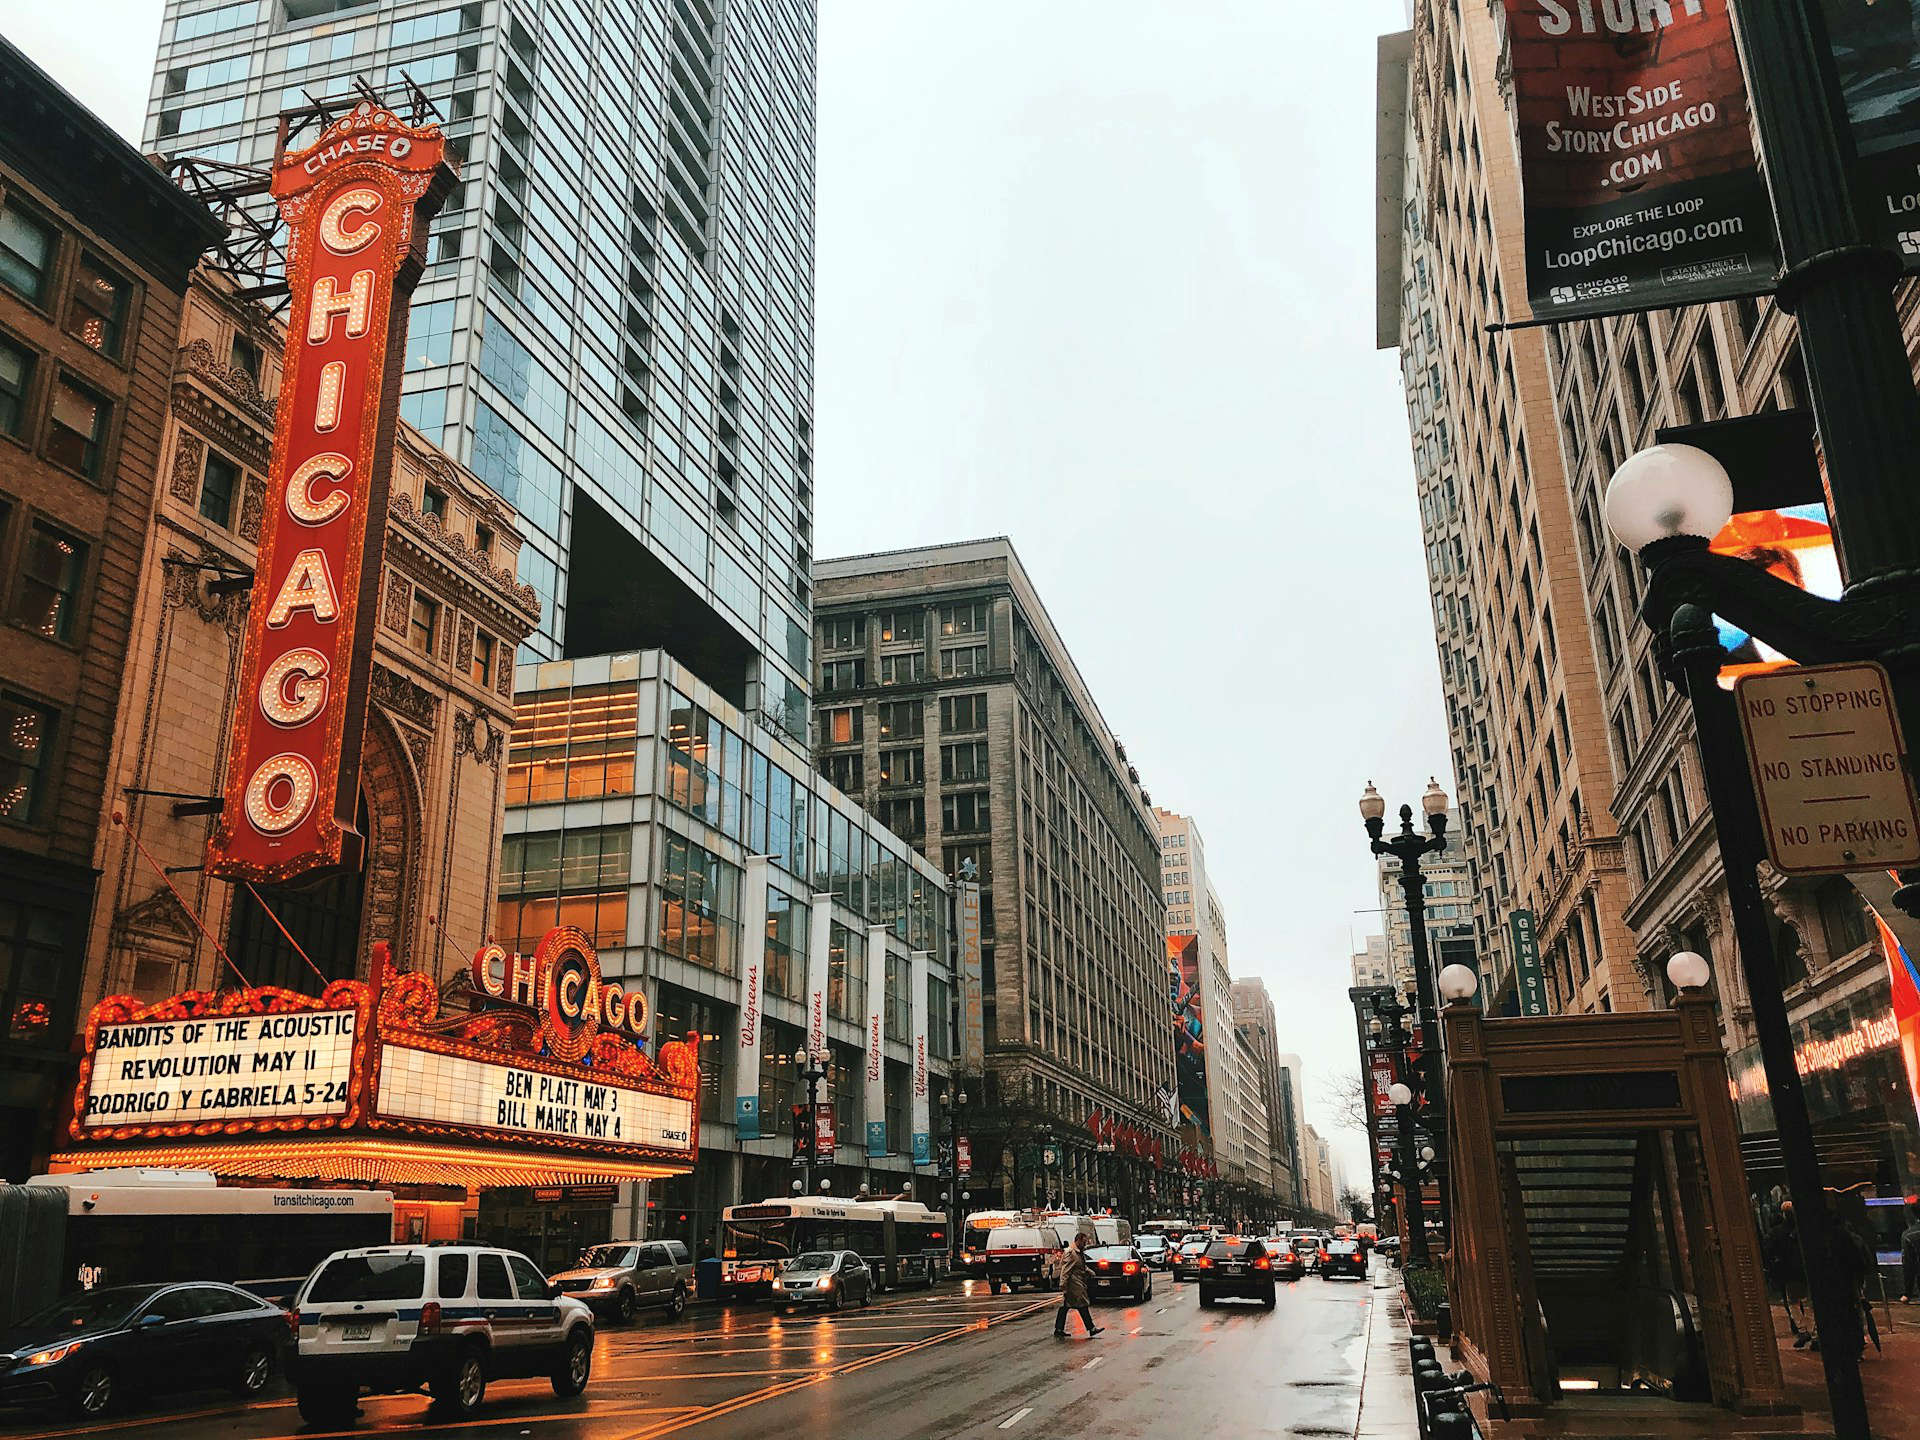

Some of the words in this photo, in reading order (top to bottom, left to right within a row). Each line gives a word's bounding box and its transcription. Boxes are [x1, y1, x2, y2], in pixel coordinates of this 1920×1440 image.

[1538, 0, 1702, 35] STOR
[304, 135, 388, 174] CHASE
[1573, 214, 1634, 239] EXPLORE
[1636, 207, 1664, 223] THE
[1666, 198, 1704, 217] LOOP
[1886, 193, 1920, 213] Lo
[1545, 215, 1744, 269] LoopChicago.com
[1576, 275, 1628, 290] CHICAGO
[1666, 271, 1702, 282] SPECIAL
[1672, 265, 1699, 275] STATE
[1701, 259, 1735, 271] STREET
[1577, 283, 1629, 298] LOOP
[244, 187, 384, 838] CHICAGO
[1750, 698, 1775, 718] NO
[1787, 688, 1881, 715] STOPPING
[1763, 761, 1790, 782] NO
[1800, 752, 1896, 778] STANDING
[1781, 826, 1809, 847] NO
[1818, 819, 1908, 843] PARKING
[965, 883, 980, 965] BALLET
[1518, 918, 1534, 968] GENE
[474, 943, 649, 1034] CHICAGO
[741, 965, 760, 1049] Walgreens
[97, 1025, 175, 1050] BANDITS
[182, 1023, 206, 1044] OF
[215, 1020, 250, 1042] THE
[258, 1014, 353, 1040] ACOUSTIC
[809, 991, 825, 1065] Walgreens
[121, 1054, 241, 1080] REVOLUTION
[253, 1051, 297, 1073] MAY
[867, 1013, 881, 1082] Walgreens
[1794, 1049, 1808, 1076] he
[1807, 1039, 1843, 1070] Chicago
[915, 1034, 928, 1098] Walgreens
[88, 1091, 169, 1114] RODRIGO
[181, 1089, 193, 1111] Y
[200, 1085, 297, 1109] GABRIELA
[303, 1081, 347, 1104] 5-24
[506, 1071, 533, 1099] BEN
[540, 1077, 579, 1105] PLATT
[584, 1085, 607, 1112] MAY
[611, 1090, 618, 1112] 3
[497, 1099, 527, 1128] BILL
[535, 1105, 578, 1134] MAHER
[585, 1112, 608, 1138] MAY
[614, 1117, 621, 1139] 4
[662, 1129, 681, 1142] CHASE
[273, 1194, 354, 1209] transitchicago.com
